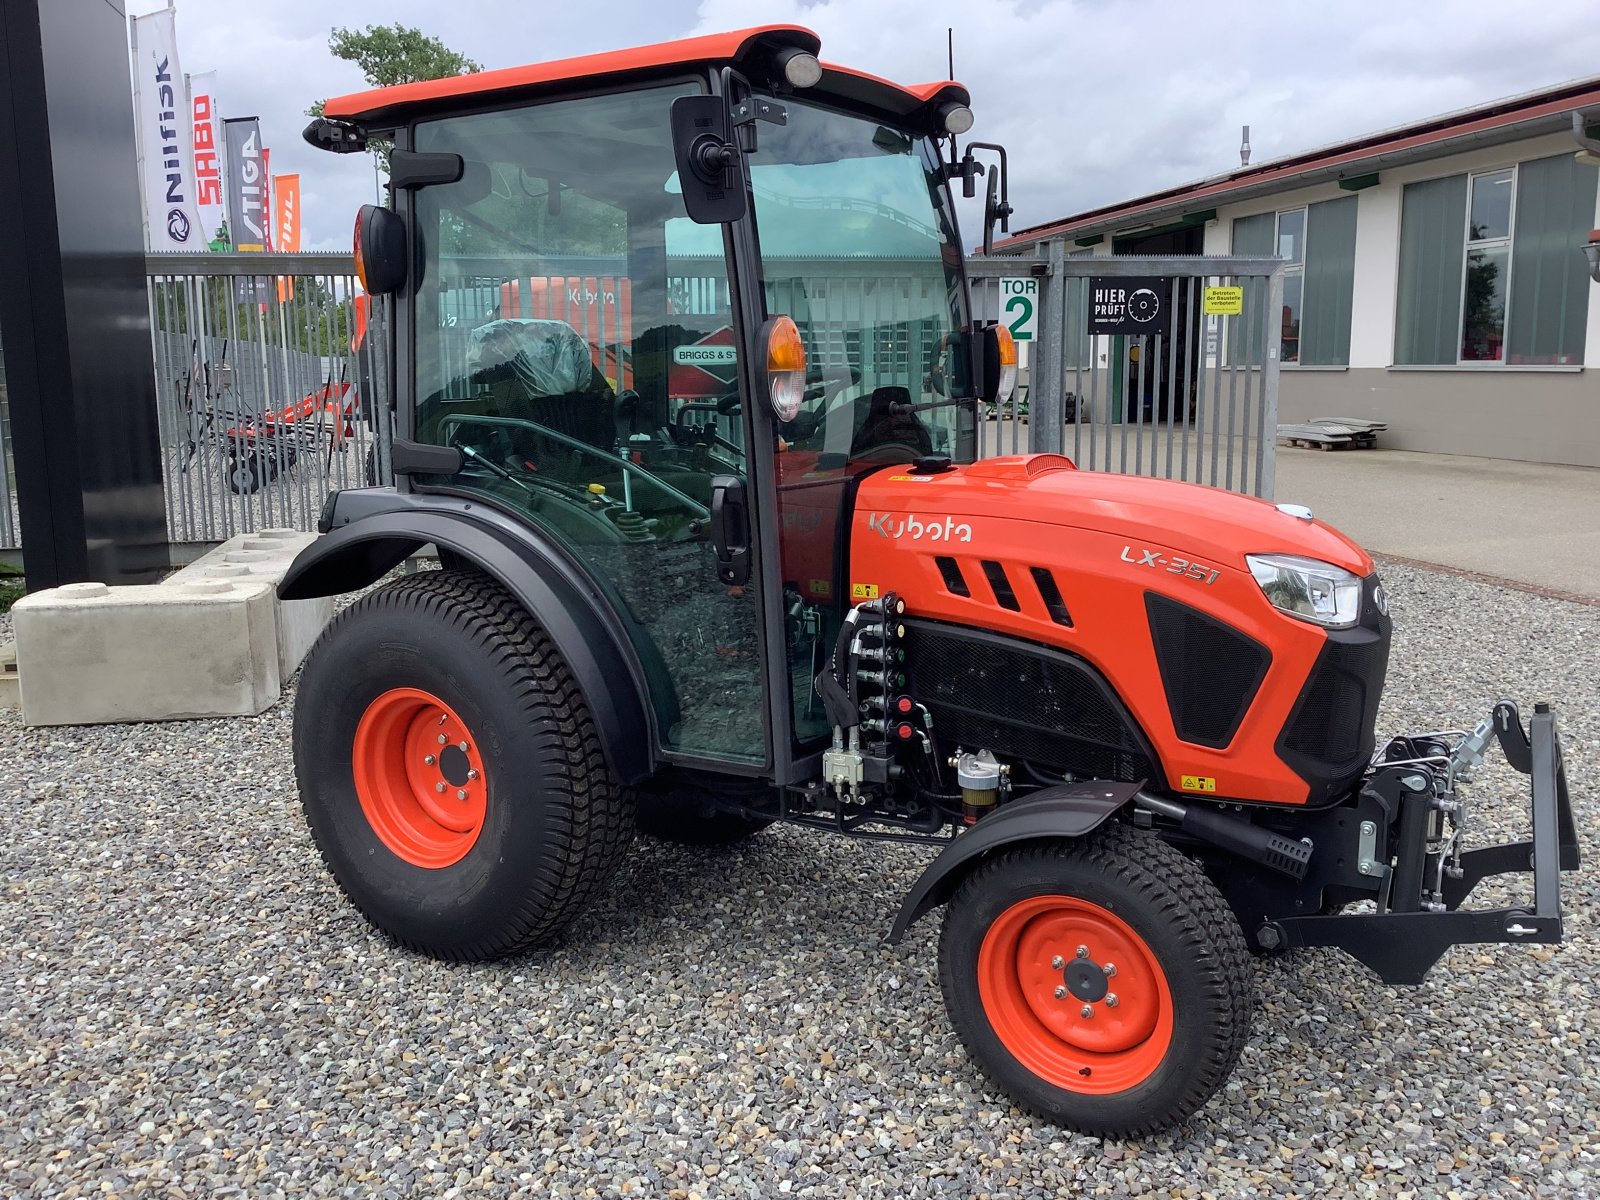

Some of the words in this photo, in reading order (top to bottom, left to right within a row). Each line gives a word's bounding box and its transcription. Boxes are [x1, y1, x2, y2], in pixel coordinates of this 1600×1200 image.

[194, 95, 221, 205] SABO
[242, 131, 263, 239] STIGA
[1002, 280, 1036, 294] TOR
[1095, 289, 1126, 303] HIER
[1005, 296, 1033, 340] 2
[1094, 302, 1126, 316] PRÜFT
[679, 351, 715, 360] BRIGGS
[717, 351, 724, 359] &
[868, 512, 972, 542] Kubota
[1120, 545, 1221, 585] LX-351
